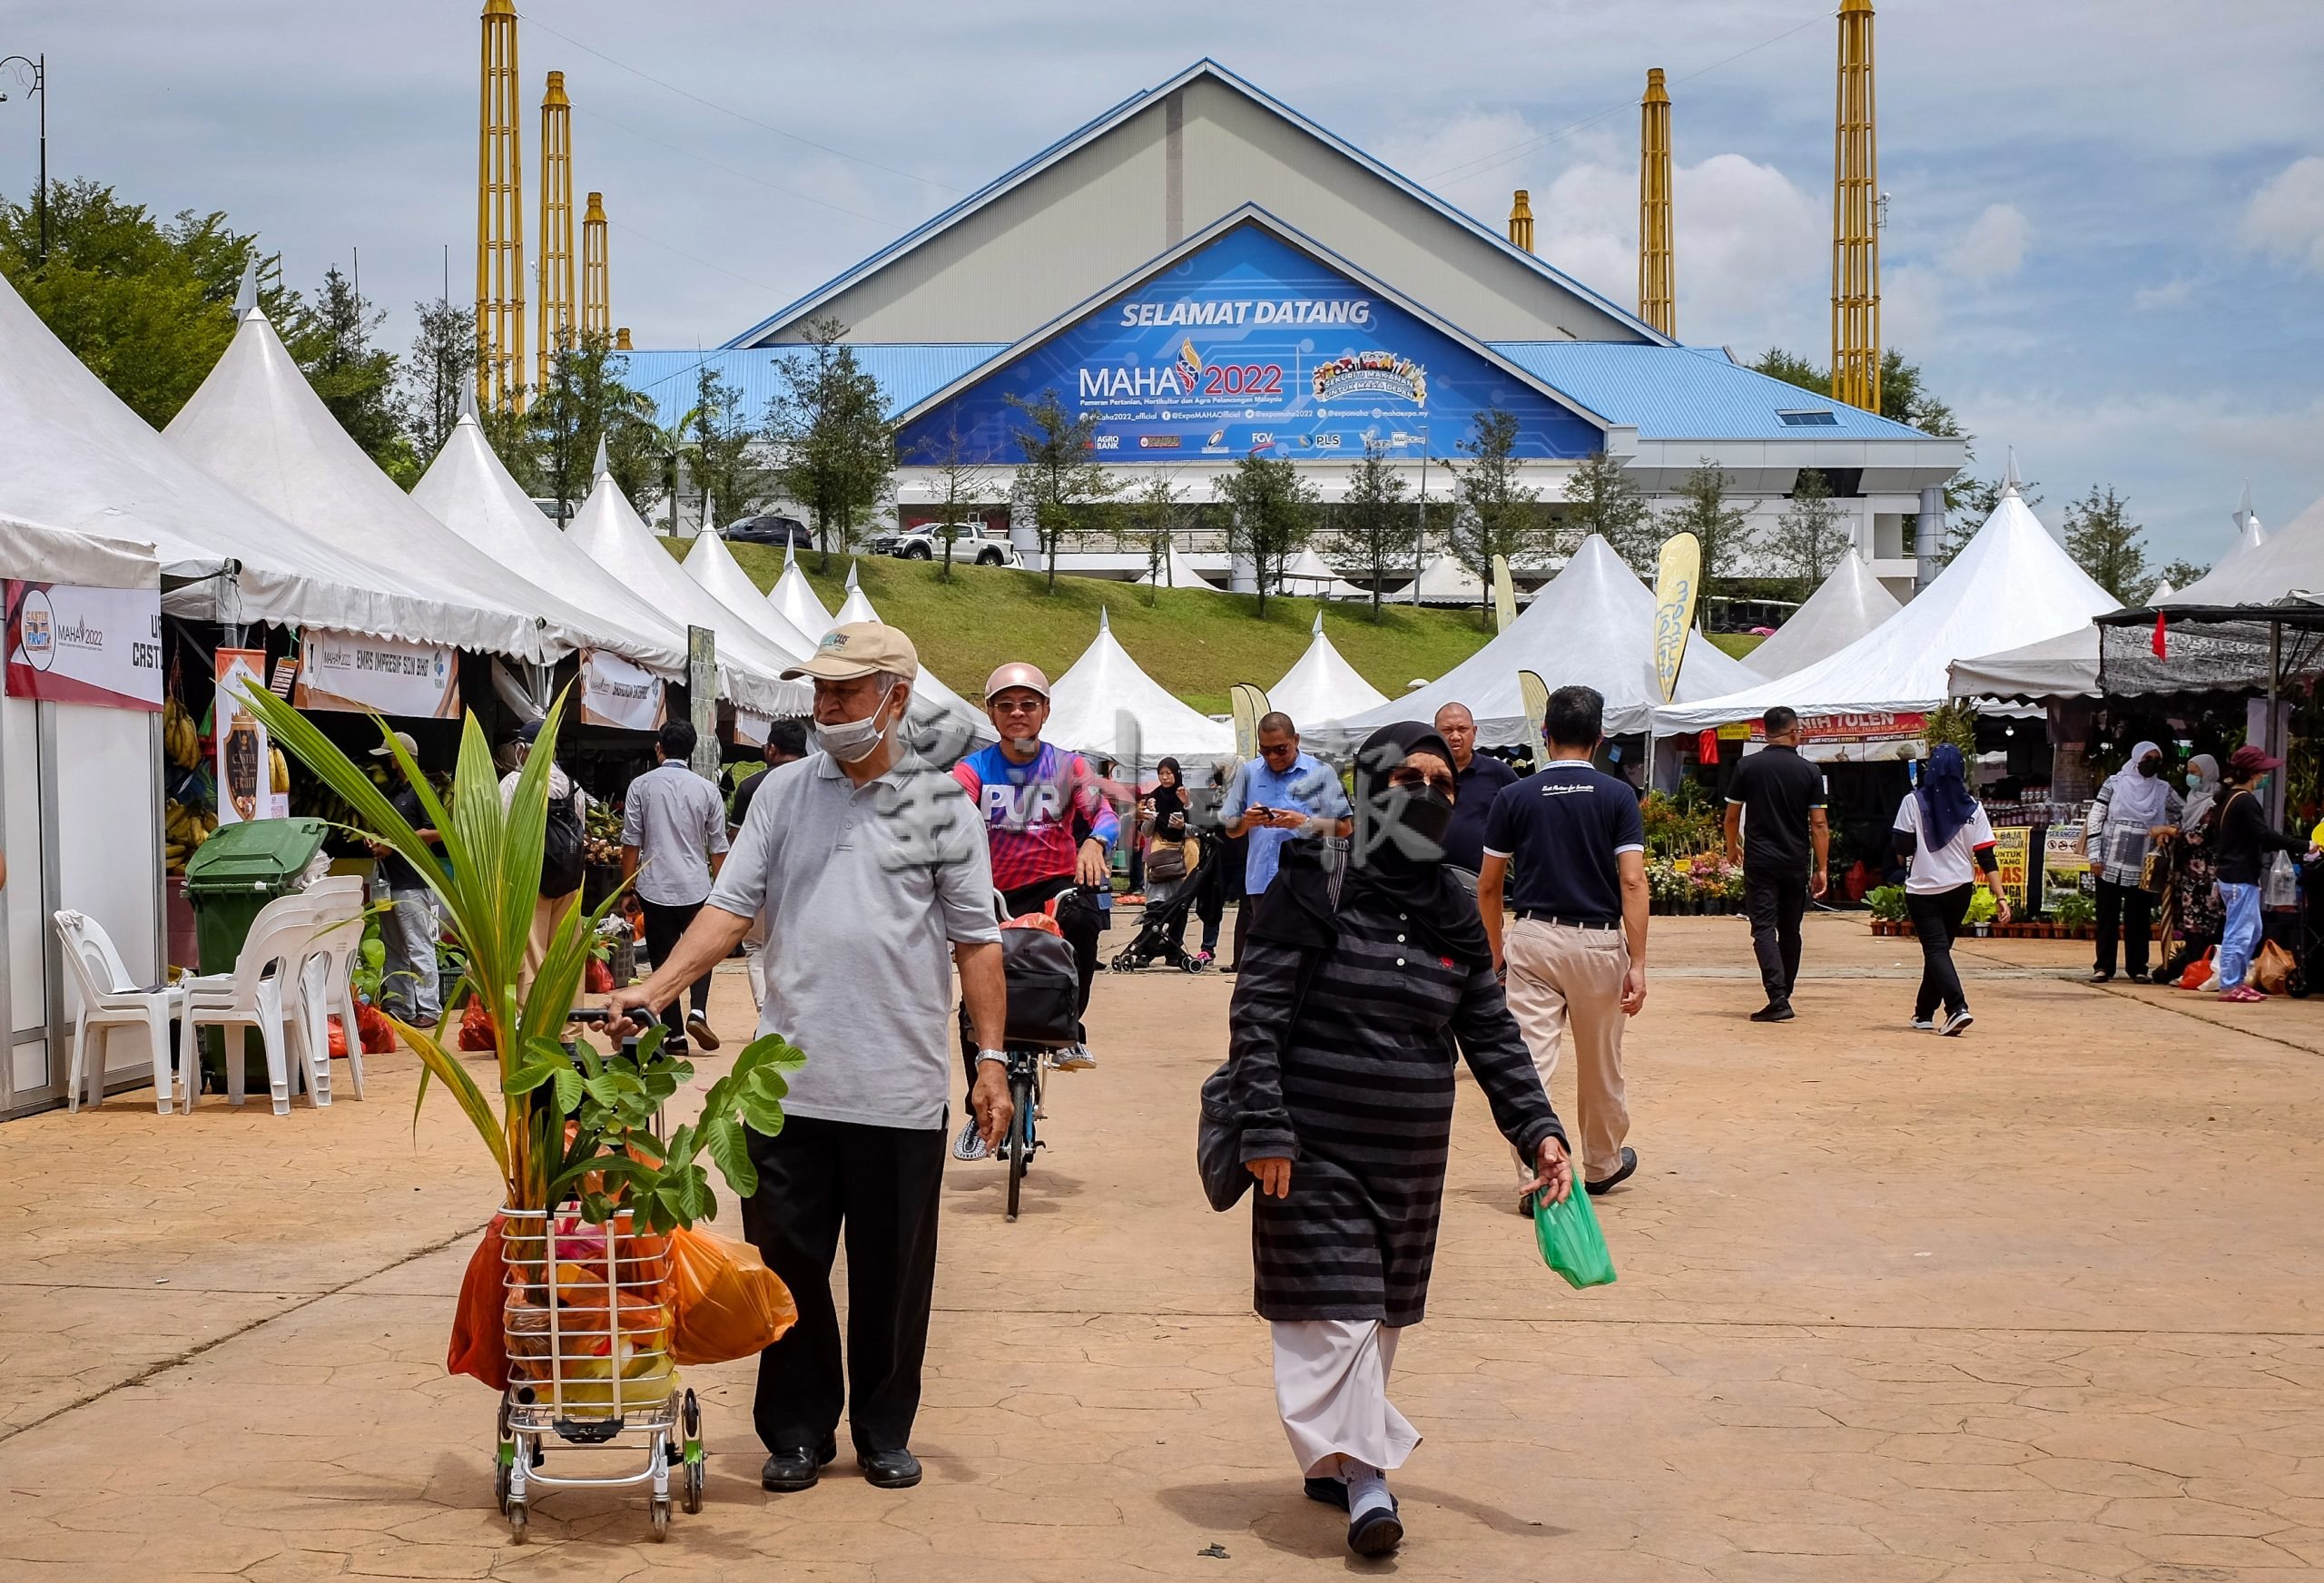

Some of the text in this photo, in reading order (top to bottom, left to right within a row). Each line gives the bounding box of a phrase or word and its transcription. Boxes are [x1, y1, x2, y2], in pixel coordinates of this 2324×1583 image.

[1120, 300, 1370, 327] SELAMAT DATANG
[1079, 363, 1283, 397] MAHA 2022
[1325, 370, 1413, 388] SEKURITI MAKANAN
[1325, 381, 1413, 399] UNTUK MASA DEPAN
[1195, 397, 1211, 405] Agro
[1212, 397, 1254, 405] Pelancongan
[1255, 396, 1283, 404] Malaysia
[1252, 433, 1274, 443] FGV
[1316, 436, 1340, 446] PLS
[57, 624, 82, 643] MAHA
[84, 628, 103, 646] 2022
[356, 649, 374, 671] EMAS
[374, 652, 402, 674] IMPRESIF
[1797, 713, 1896, 730] NIH TULEN
[980, 784, 1063, 822] PUR
[2000, 831, 2022, 840] BAJA
